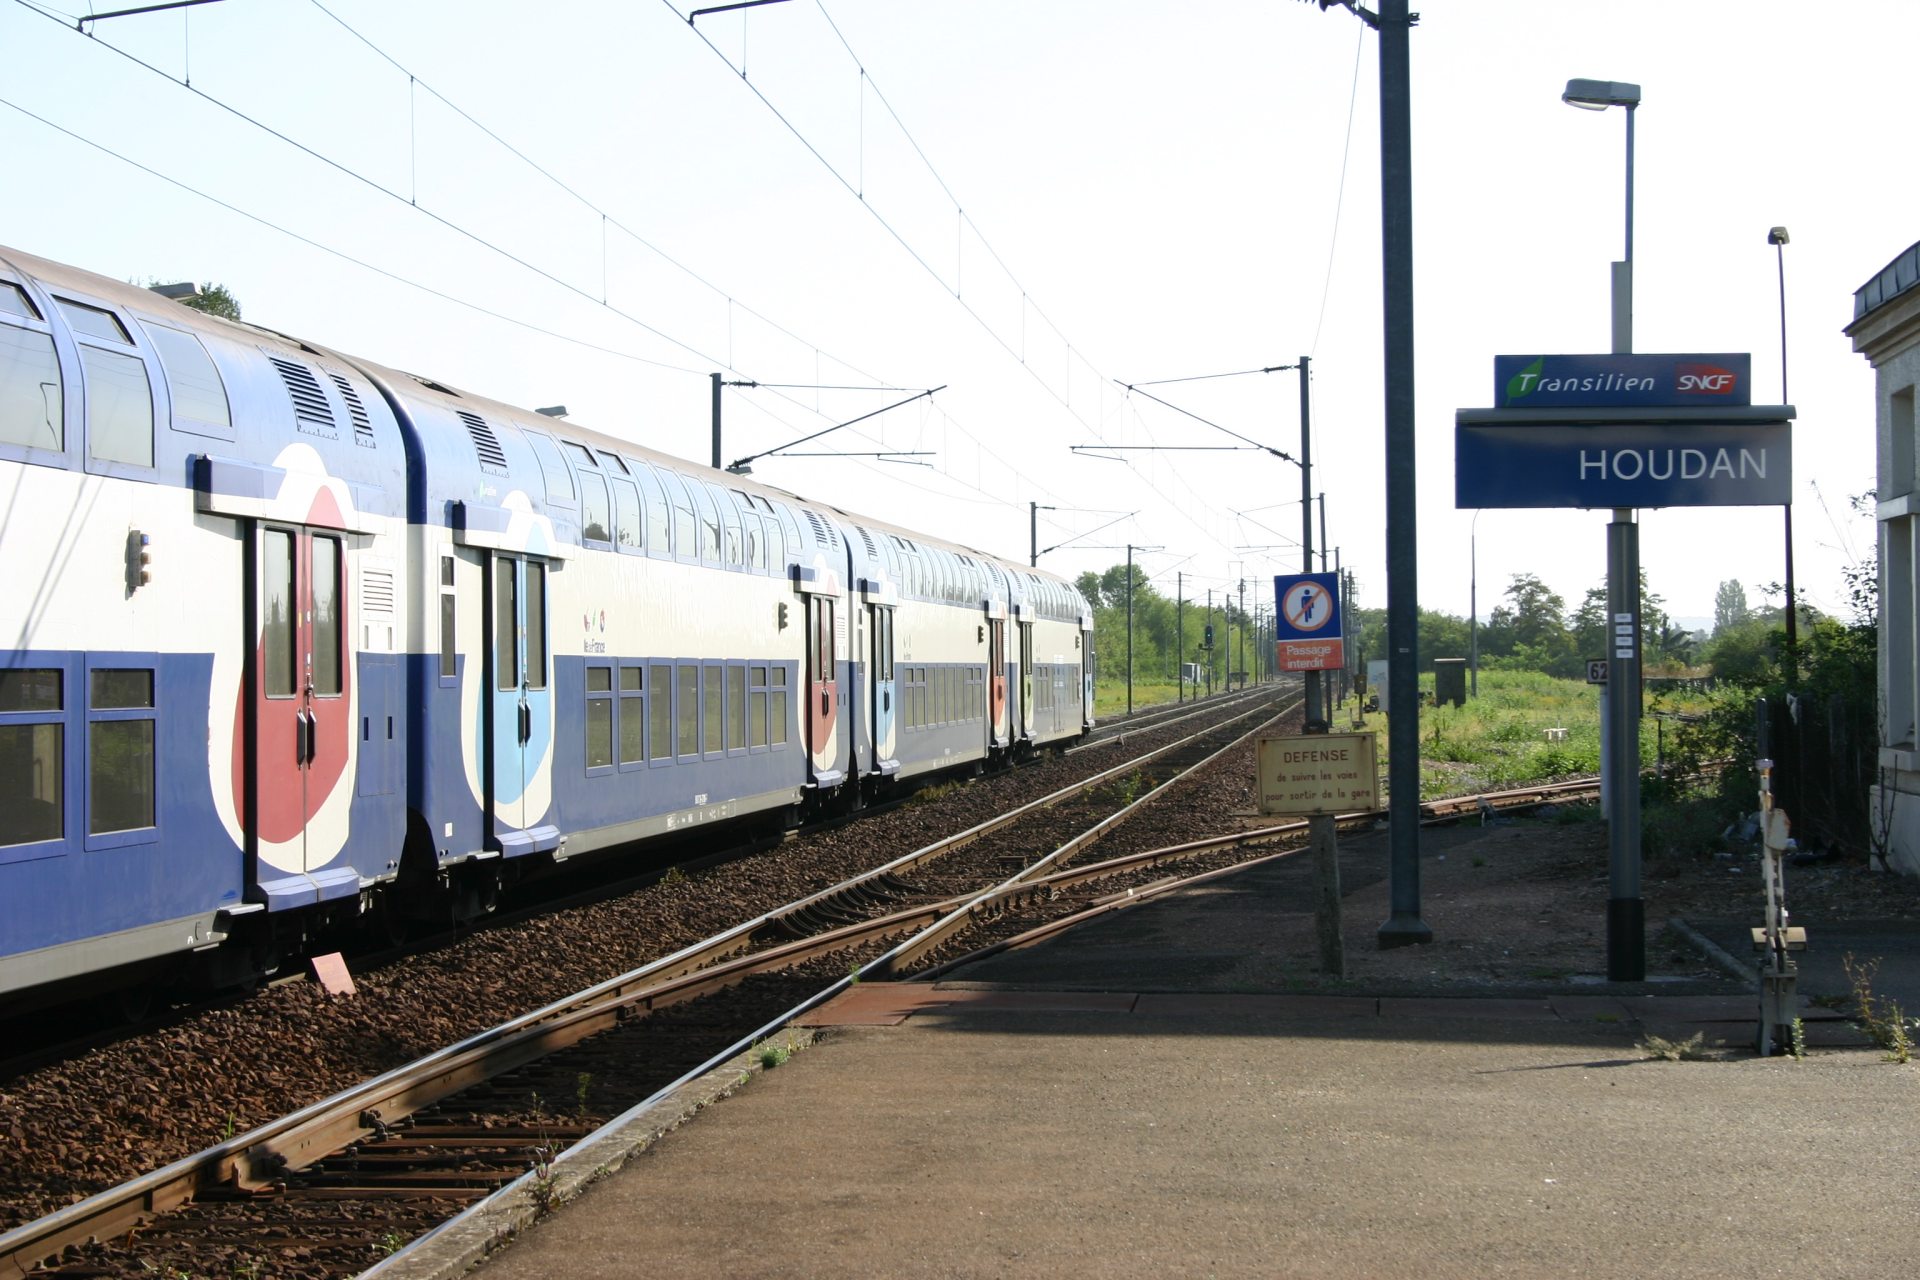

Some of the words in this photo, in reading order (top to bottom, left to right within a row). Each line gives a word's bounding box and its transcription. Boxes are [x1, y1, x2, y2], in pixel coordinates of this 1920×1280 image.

[1520, 373, 1656, 392] Transilien
[1677, 374, 1733, 391] SNCF
[1579, 448, 1767, 480] HOUDAN
[1286, 645, 1331, 656] Passage
[1287, 658, 1324, 668] interdit
[1283, 749, 1349, 764] DEFENSE
[1276, 772, 1286, 783] de
[1292, 772, 1316, 782] suivre
[1320, 770, 1332, 780] les
[1337, 770, 1358, 780] voies
[1265, 793, 1284, 804] pour
[1290, 790, 1317, 800] sortir
[1322, 789, 1333, 799] de
[1337, 788, 1346, 798] la
[1351, 790, 1370, 801] gare
